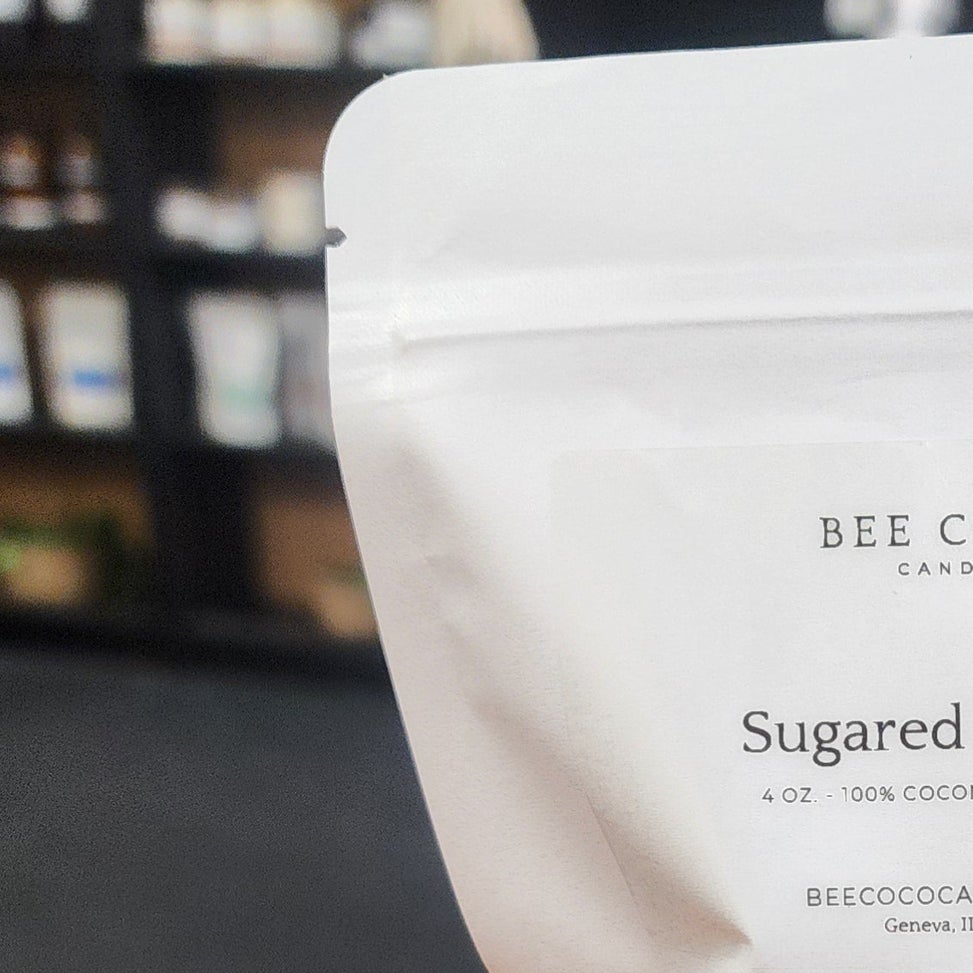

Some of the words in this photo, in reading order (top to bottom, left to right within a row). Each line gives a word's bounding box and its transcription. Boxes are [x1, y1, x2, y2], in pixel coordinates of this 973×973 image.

[818, 514, 911, 549] BEE
[742, 701, 966, 768] Sugared
[761, 787, 775, 804] 4
[781, 786, 818, 804] OZ.
[841, 785, 896, 803] 100%
[884, 917, 956, 934] Geneva,
